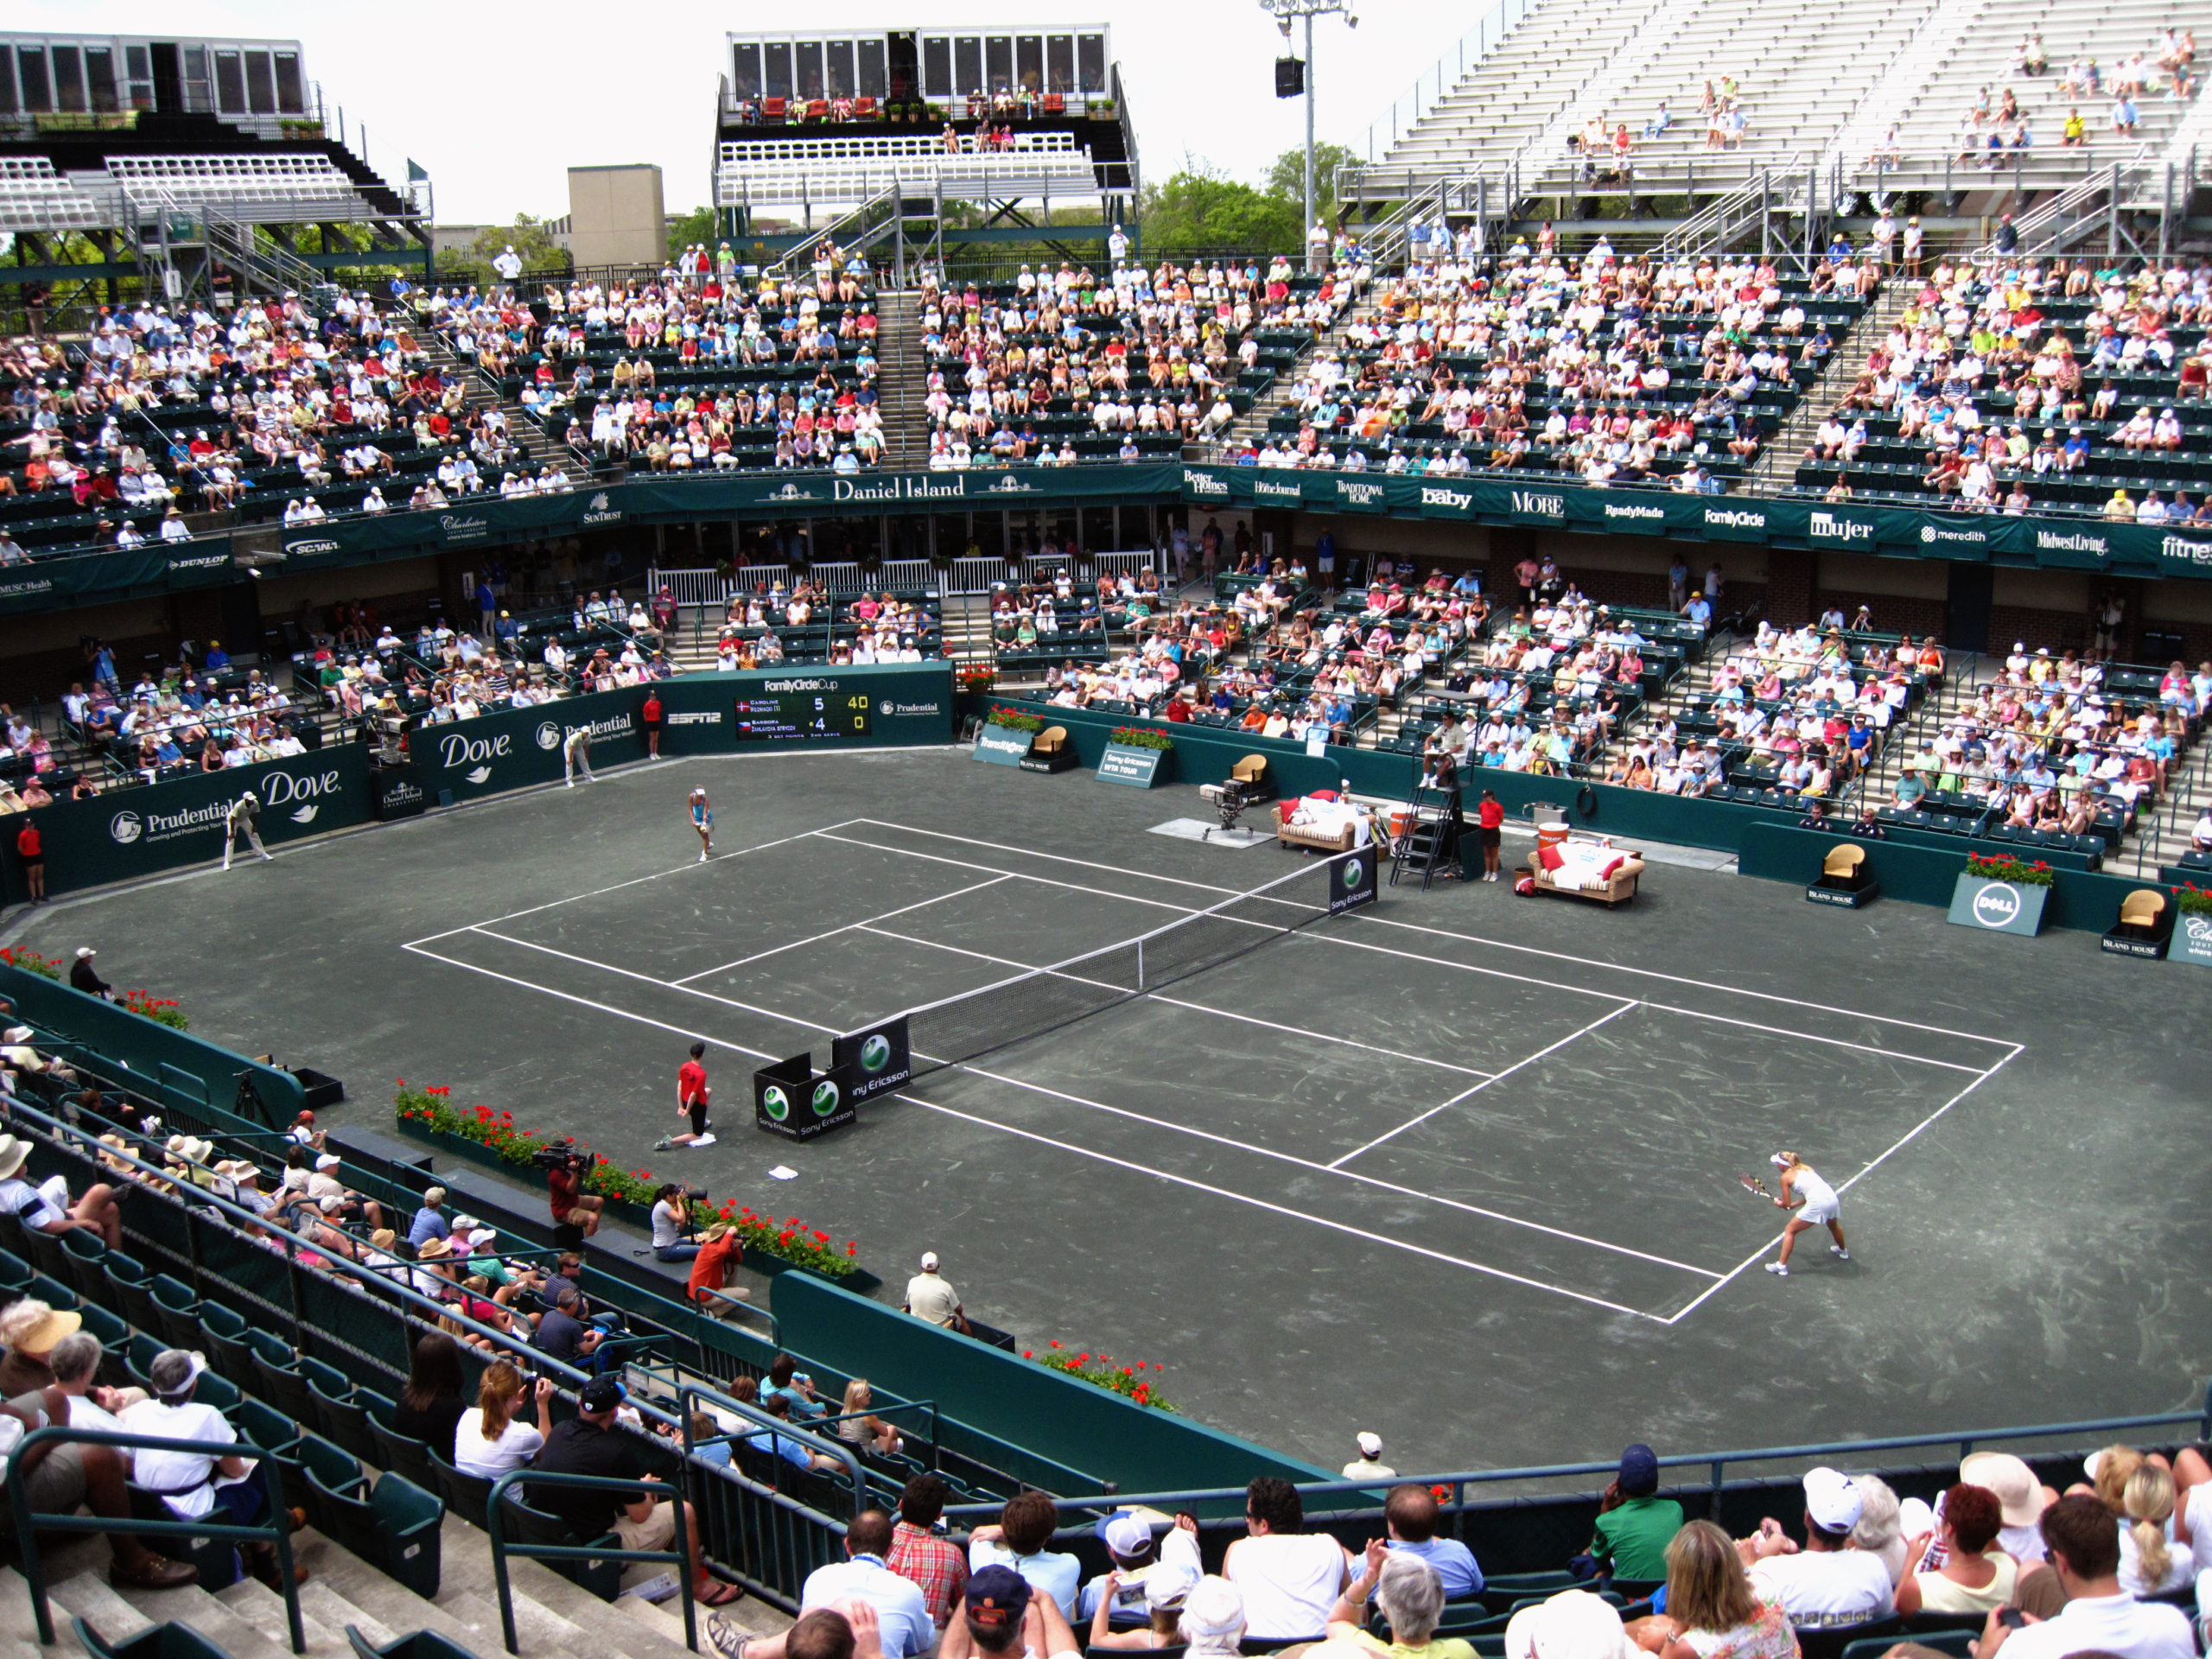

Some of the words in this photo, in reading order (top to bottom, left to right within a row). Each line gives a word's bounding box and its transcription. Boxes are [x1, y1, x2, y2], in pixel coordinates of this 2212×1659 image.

[1184, 469, 1213, 482] Better
[833, 476, 900, 500] Daniel
[906, 474, 964, 499] Island
[1193, 480, 1228, 493] Homes
[1336, 480, 1384, 496] TRADITIONAL
[1349, 493, 1372, 504] HOME
[1421, 487, 1472, 510] baby
[1511, 491, 1564, 514] MORE
[1605, 504, 1664, 518] ReadyMade
[440, 515, 486, 530] Charleston
[1811, 512, 1873, 541] mujer
[1937, 530, 1986, 543] meredith
[296, 541, 338, 554] SCANA
[180, 555, 229, 568] DUNLOP
[0, 582, 26, 594] MUSC
[27, 579, 52, 589] Health
[815, 697, 824, 710] 5
[848, 696, 868, 709] 40
[897, 702, 938, 712] Prudential
[563, 713, 632, 738] Prdential
[668, 712, 721, 725] ESPN2
[815, 717, 825, 730] 4
[854, 715, 864, 729] 0
[440, 734, 510, 768] Dove
[1107, 753, 1124, 765] Sony
[1124, 757, 1152, 767] Ericsson
[1104, 764, 1119, 772] WTA
[1120, 766, 1138, 775] TOUR
[261, 770, 340, 806] Dove
[147, 798, 234, 833] Prudential
[146, 833, 170, 842] Growing
[181, 824, 209, 835] Protecting
[1332, 898, 1347, 910] Sony
[1347, 889, 1372, 904] Ericsson
[1808, 890, 1831, 900] ISLAND
[1832, 894, 1853, 905] HOUSE
[1978, 896, 2014, 912] DELL
[2102, 938, 2129, 950] ISLAND
[2131, 945, 2157, 956] HOUSE
[852, 1085, 867, 1096] ny
[868, 1070, 909, 1090] Ericsson
[759, 1117, 774, 1128] Sony
[773, 1122, 797, 1135] Ericsson
[801, 1124, 820, 1135] Sony
[822, 1109, 854, 1127] Ericsson
